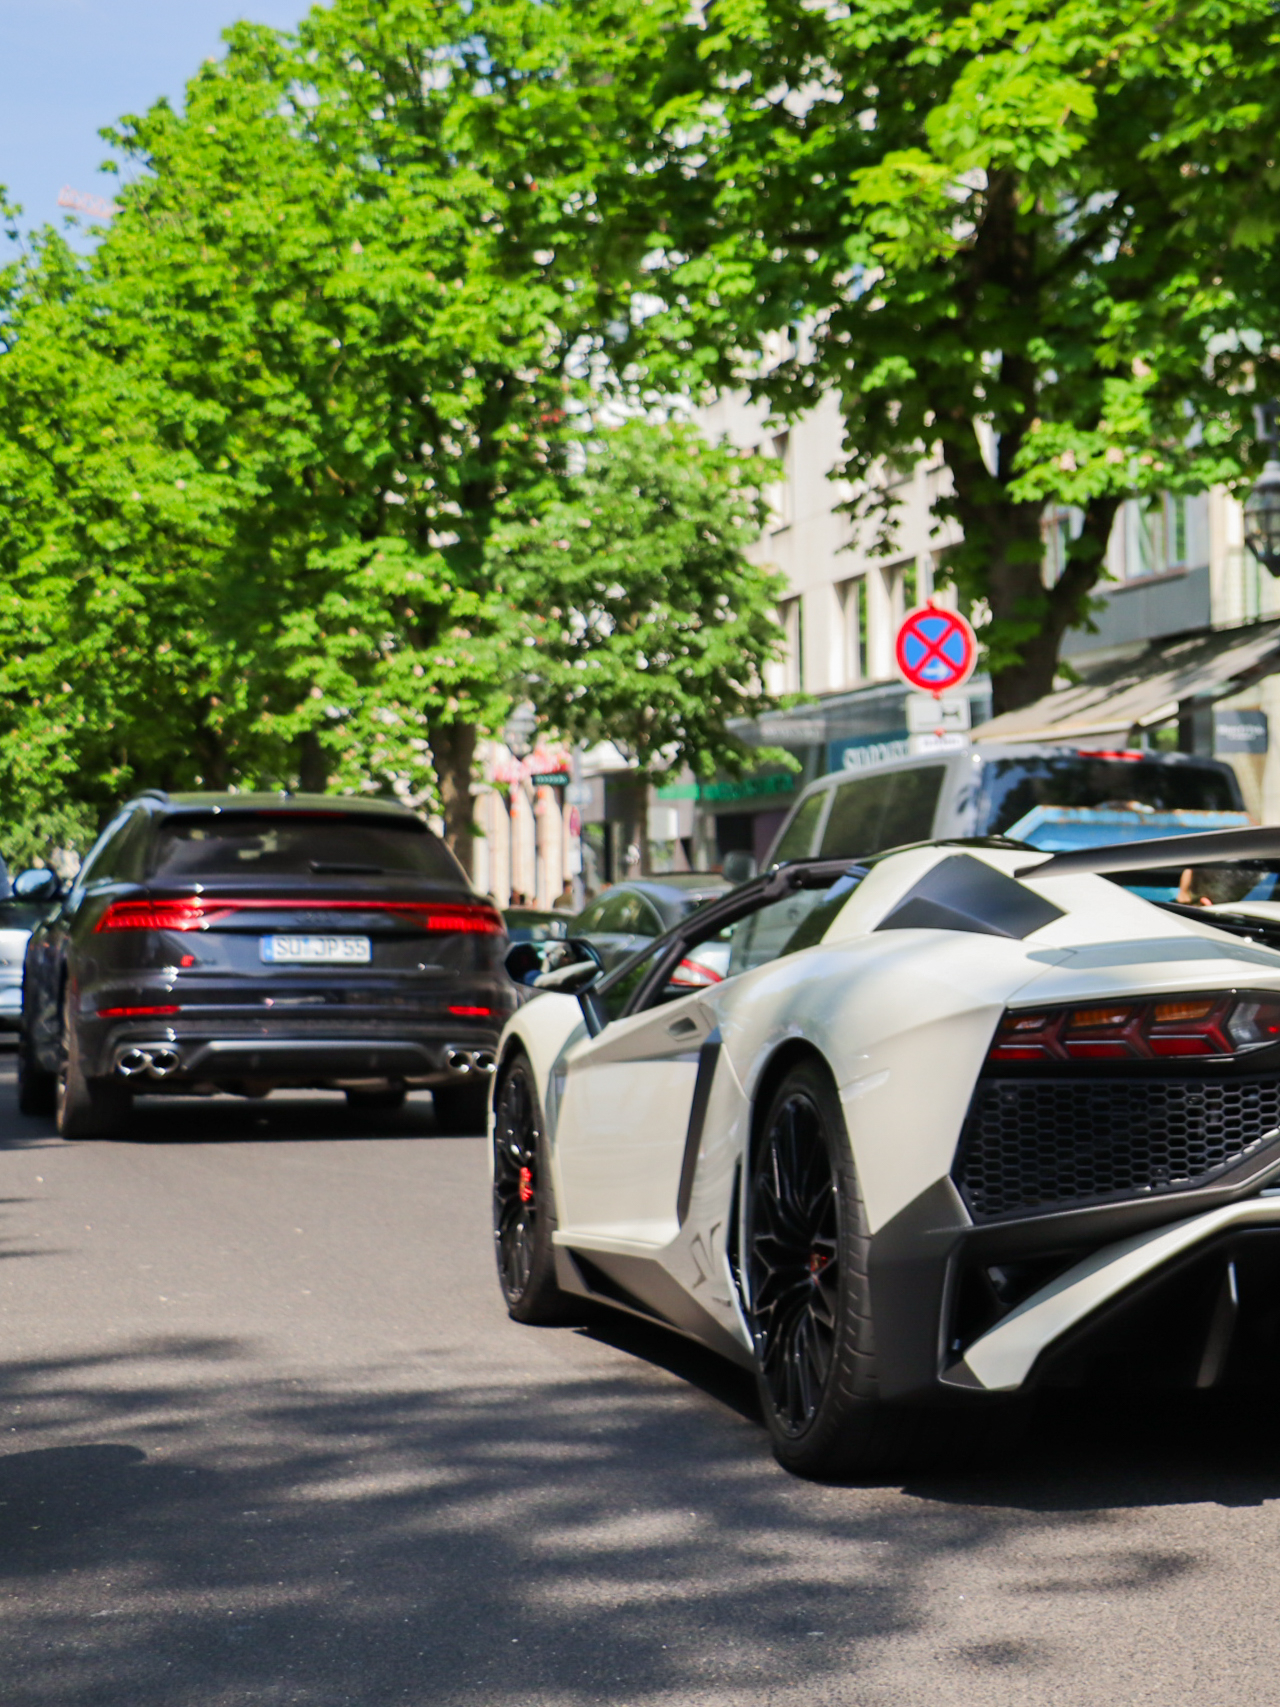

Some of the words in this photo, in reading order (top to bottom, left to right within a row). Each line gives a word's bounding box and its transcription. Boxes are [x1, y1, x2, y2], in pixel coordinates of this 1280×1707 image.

[277, 937, 301, 955] SU
[315, 937, 338, 956] JP
[344, 938, 367, 956] 55
